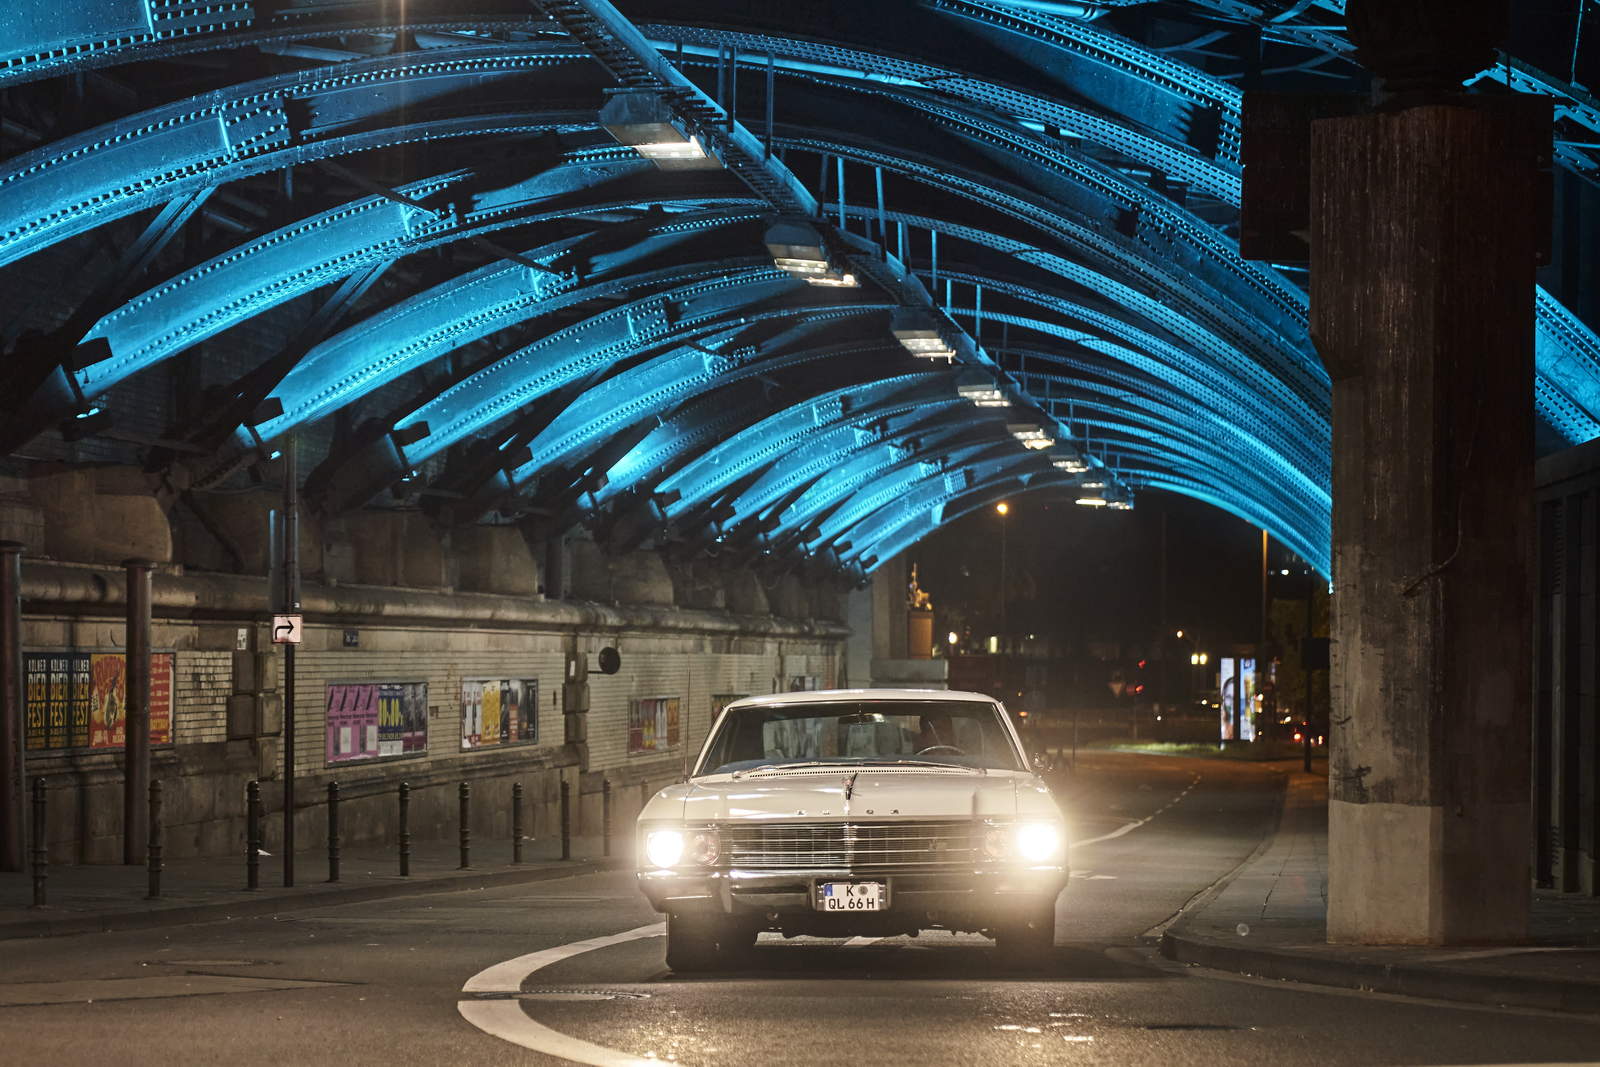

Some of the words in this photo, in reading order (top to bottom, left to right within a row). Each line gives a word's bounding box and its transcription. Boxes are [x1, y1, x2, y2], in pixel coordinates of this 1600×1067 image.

[27, 702, 46, 729] FEST
[50, 701, 68, 727] FEST
[72, 700, 89, 726] FEST
[829, 898, 845, 909] QL
[848, 898, 864, 909] 66
[866, 898, 875, 909] H
[846, 885, 854, 897] K
